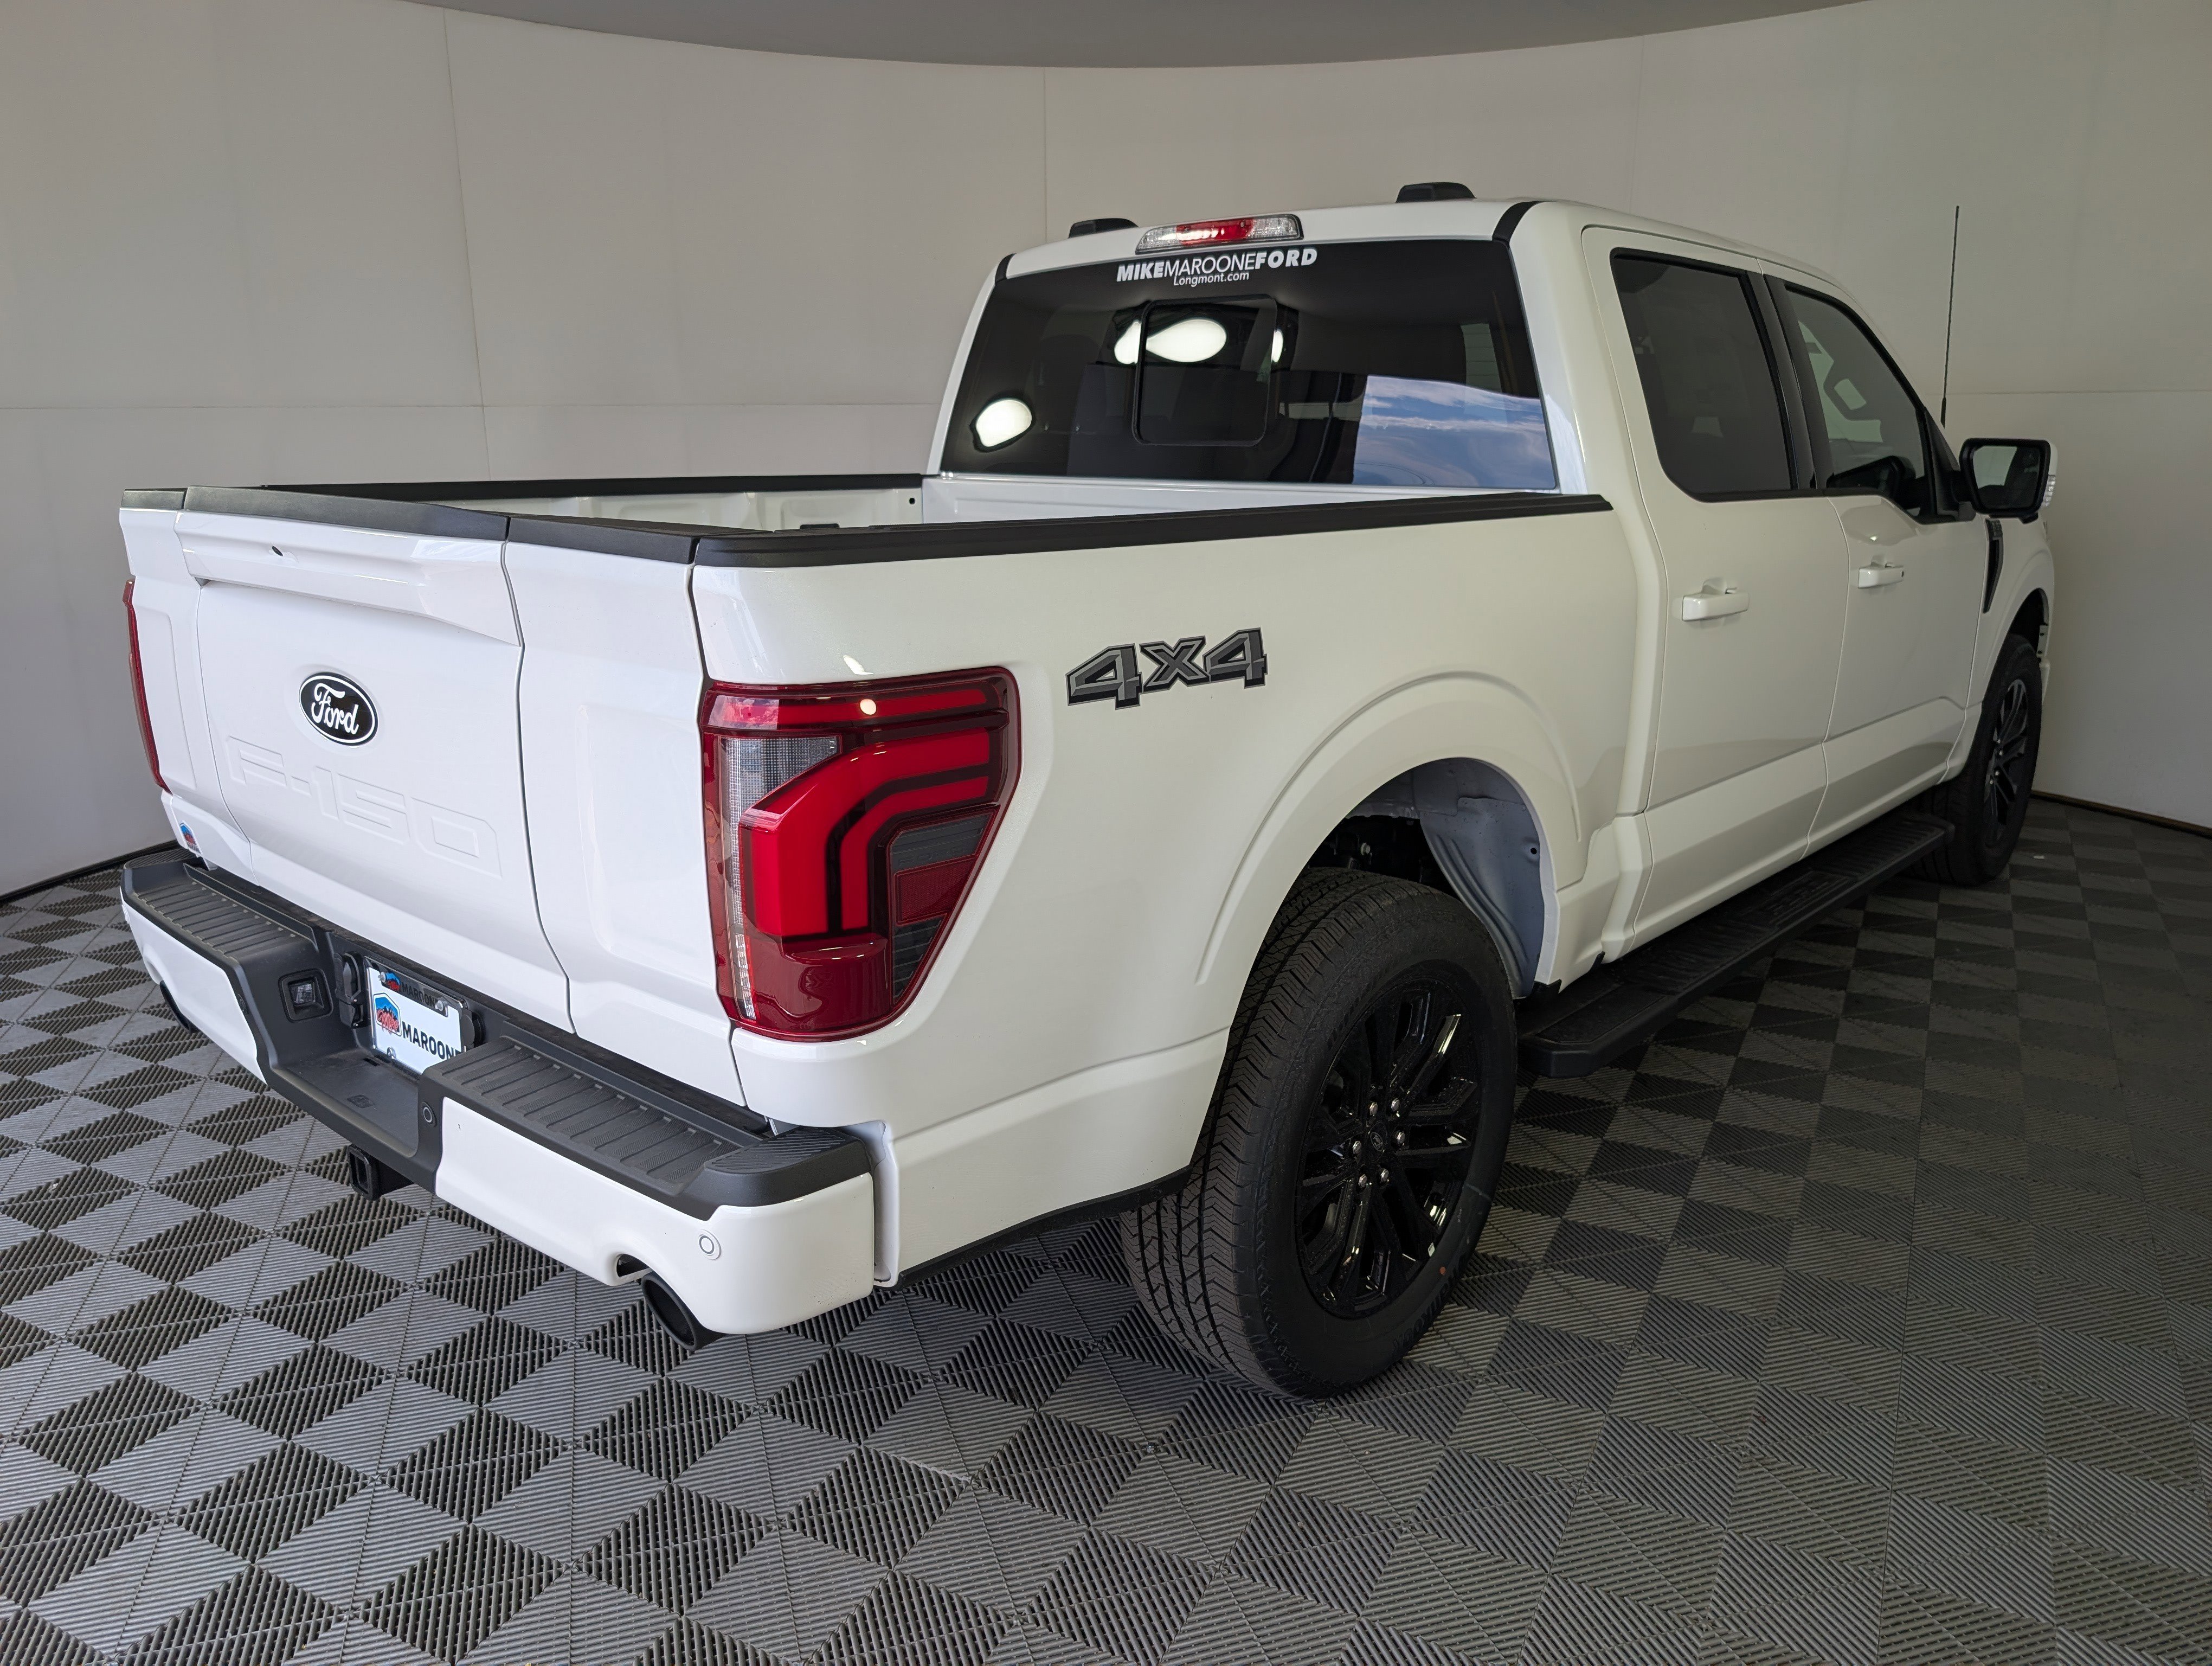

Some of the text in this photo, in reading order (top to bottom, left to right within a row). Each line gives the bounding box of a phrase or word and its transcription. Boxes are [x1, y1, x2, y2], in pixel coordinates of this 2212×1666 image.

[1117, 247, 1317, 281] MIKEMAROONEFORD
[1173, 272, 1249, 287] Longmont.com
[226, 735, 503, 880] F-150
